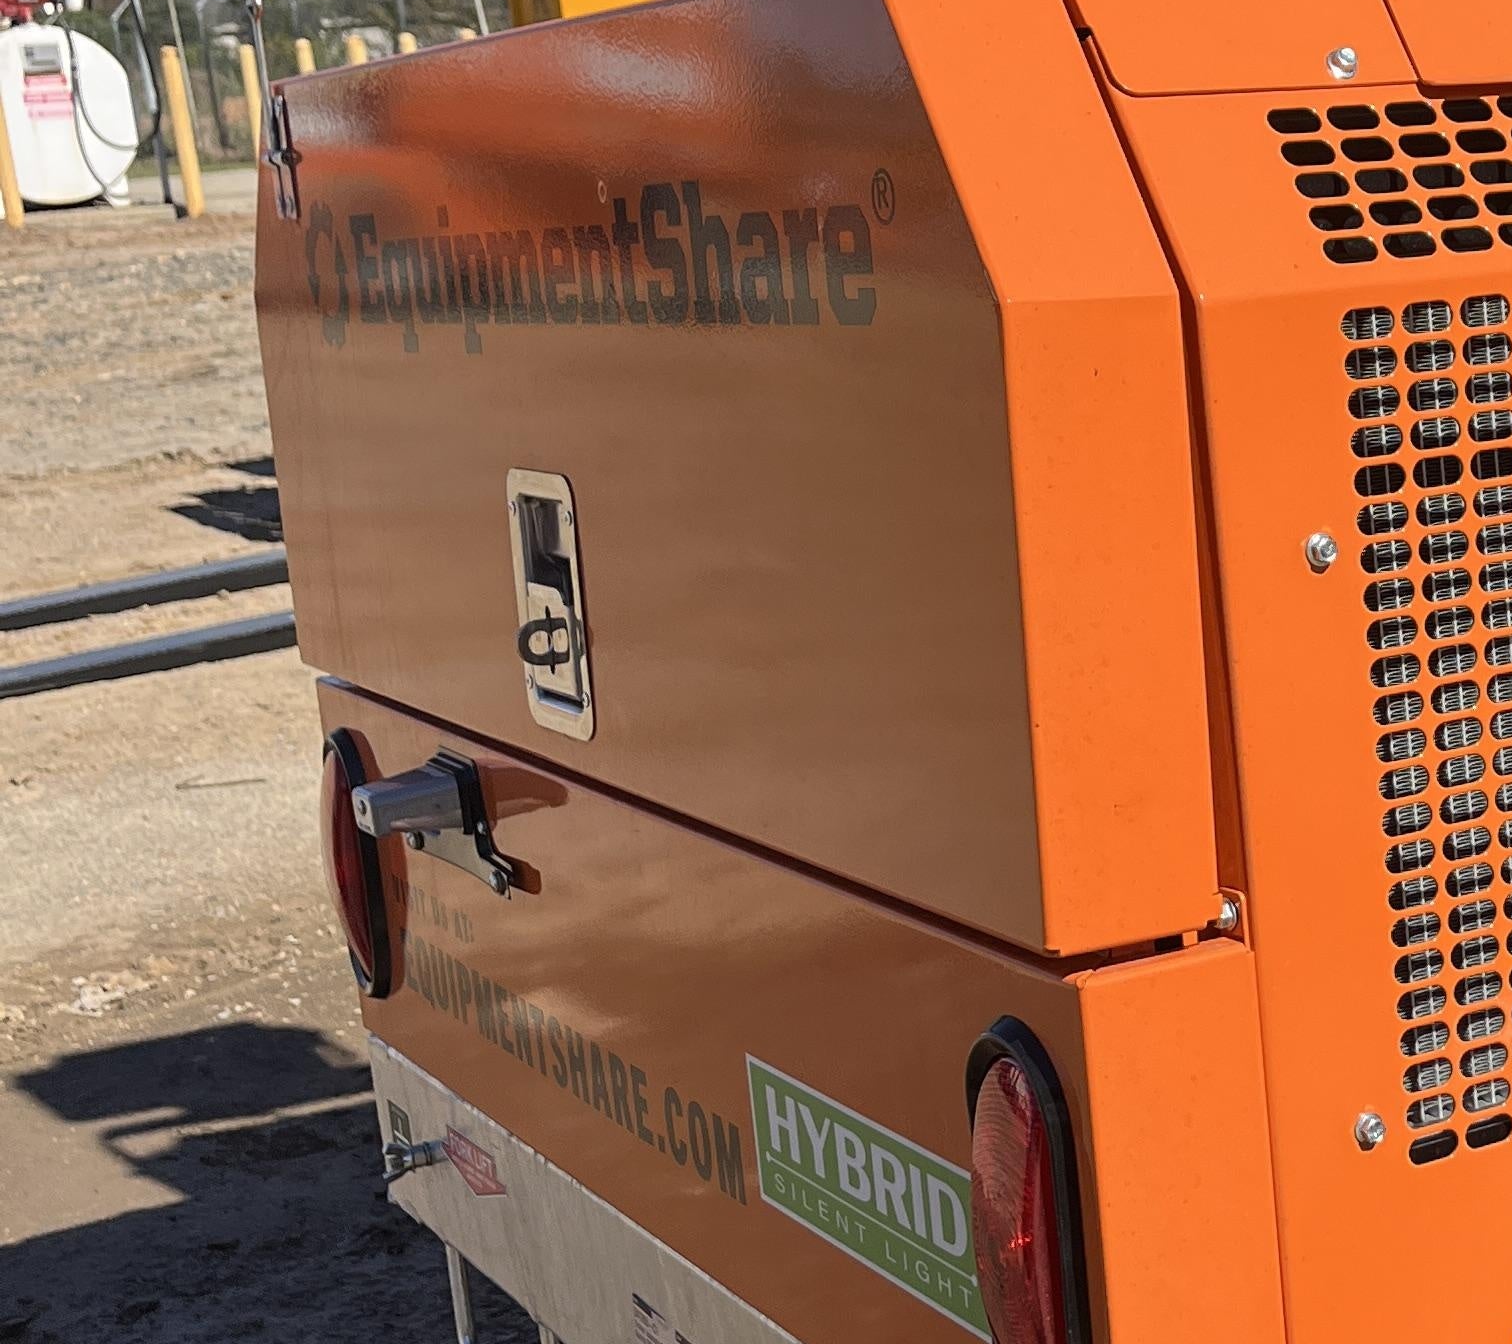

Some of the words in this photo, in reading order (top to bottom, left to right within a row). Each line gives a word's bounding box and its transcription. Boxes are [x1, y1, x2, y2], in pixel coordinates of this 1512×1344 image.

[765, 1083, 968, 1257] HYBRID
[774, 1171, 866, 1244] SILENT
[885, 1239, 973, 1309] LIGHT
